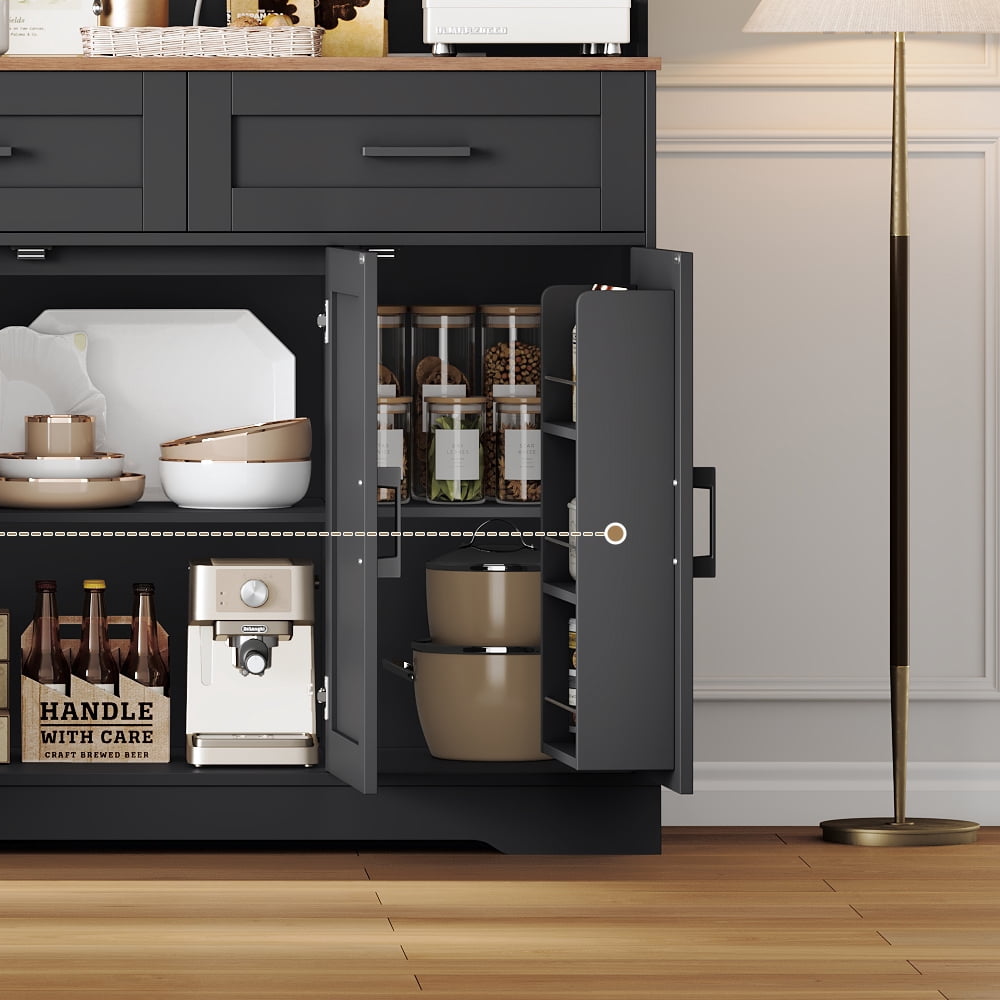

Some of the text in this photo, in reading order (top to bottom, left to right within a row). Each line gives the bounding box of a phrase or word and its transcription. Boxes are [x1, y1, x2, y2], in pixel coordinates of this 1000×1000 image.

[40, 702, 153, 721] HANDLE
[40, 730, 153, 744] WITH CARE
[44, 751, 149, 759] CRAFT BREWED BEER
